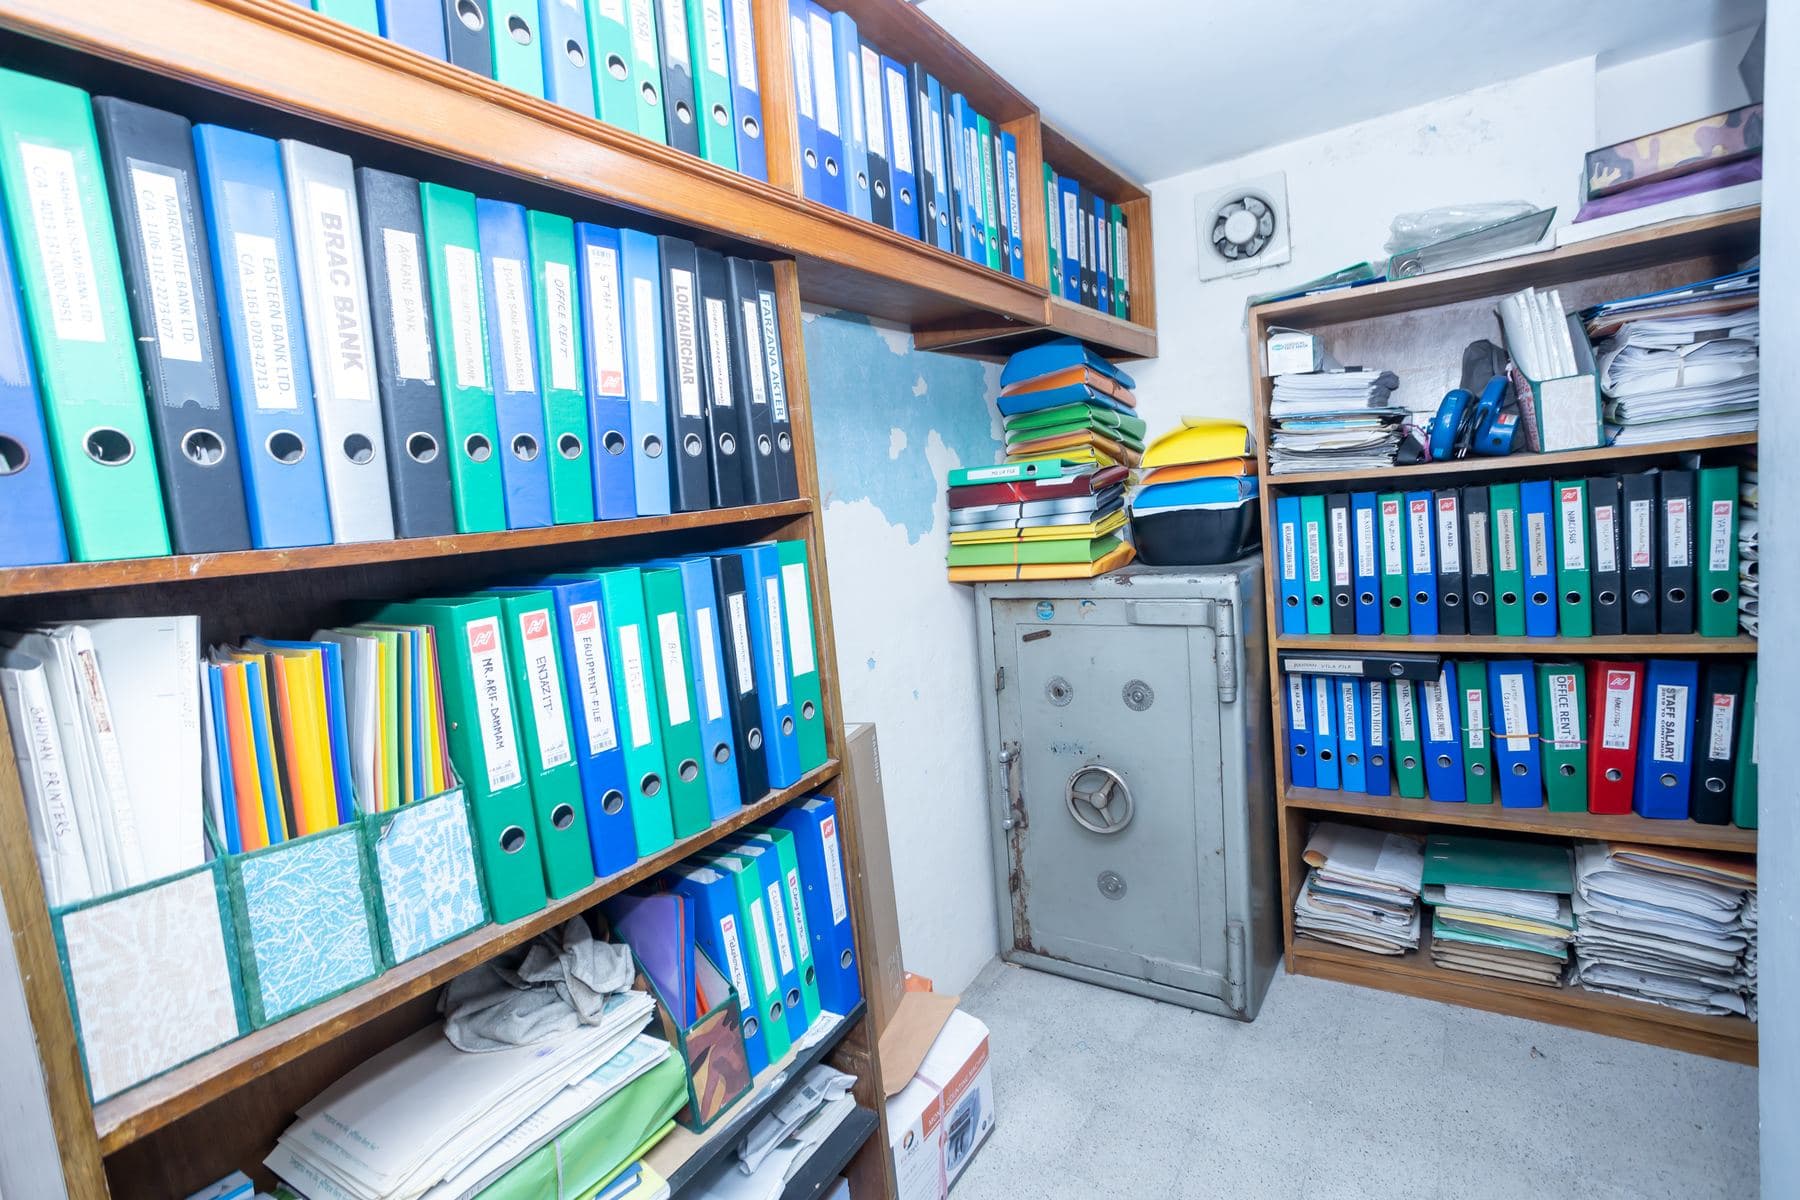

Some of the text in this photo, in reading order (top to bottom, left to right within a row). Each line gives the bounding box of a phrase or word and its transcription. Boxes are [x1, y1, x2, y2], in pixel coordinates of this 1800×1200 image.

[164, 195, 188, 277] MARCANTILE
[1010, 186, 1021, 235] SUMON
[175, 280, 191, 316] BANK
[262, 256, 283, 320] EASTERN
[320, 211, 365, 372] BRAC BANK
[271, 323, 288, 364] BANK
[554, 279, 569, 359] OFFICE RENT
[675, 284, 695, 385] LOKHAIRCHAR
[761, 299, 785, 417] FARZANA AKTER
[1714, 518, 1727, 555] VAT FILE
[1345, 704, 1353, 725] OFFICE
[1371, 681, 1382, 745] NIKETON HOUSE
[1402, 684, 1411, 700] MR.
[1403, 701, 1413, 727] NASIR
[1435, 703, 1445, 721] HOUSE
[1557, 676, 1572, 736] OFFICE RENT
[1665, 687, 1676, 760] STAFF SALARY
